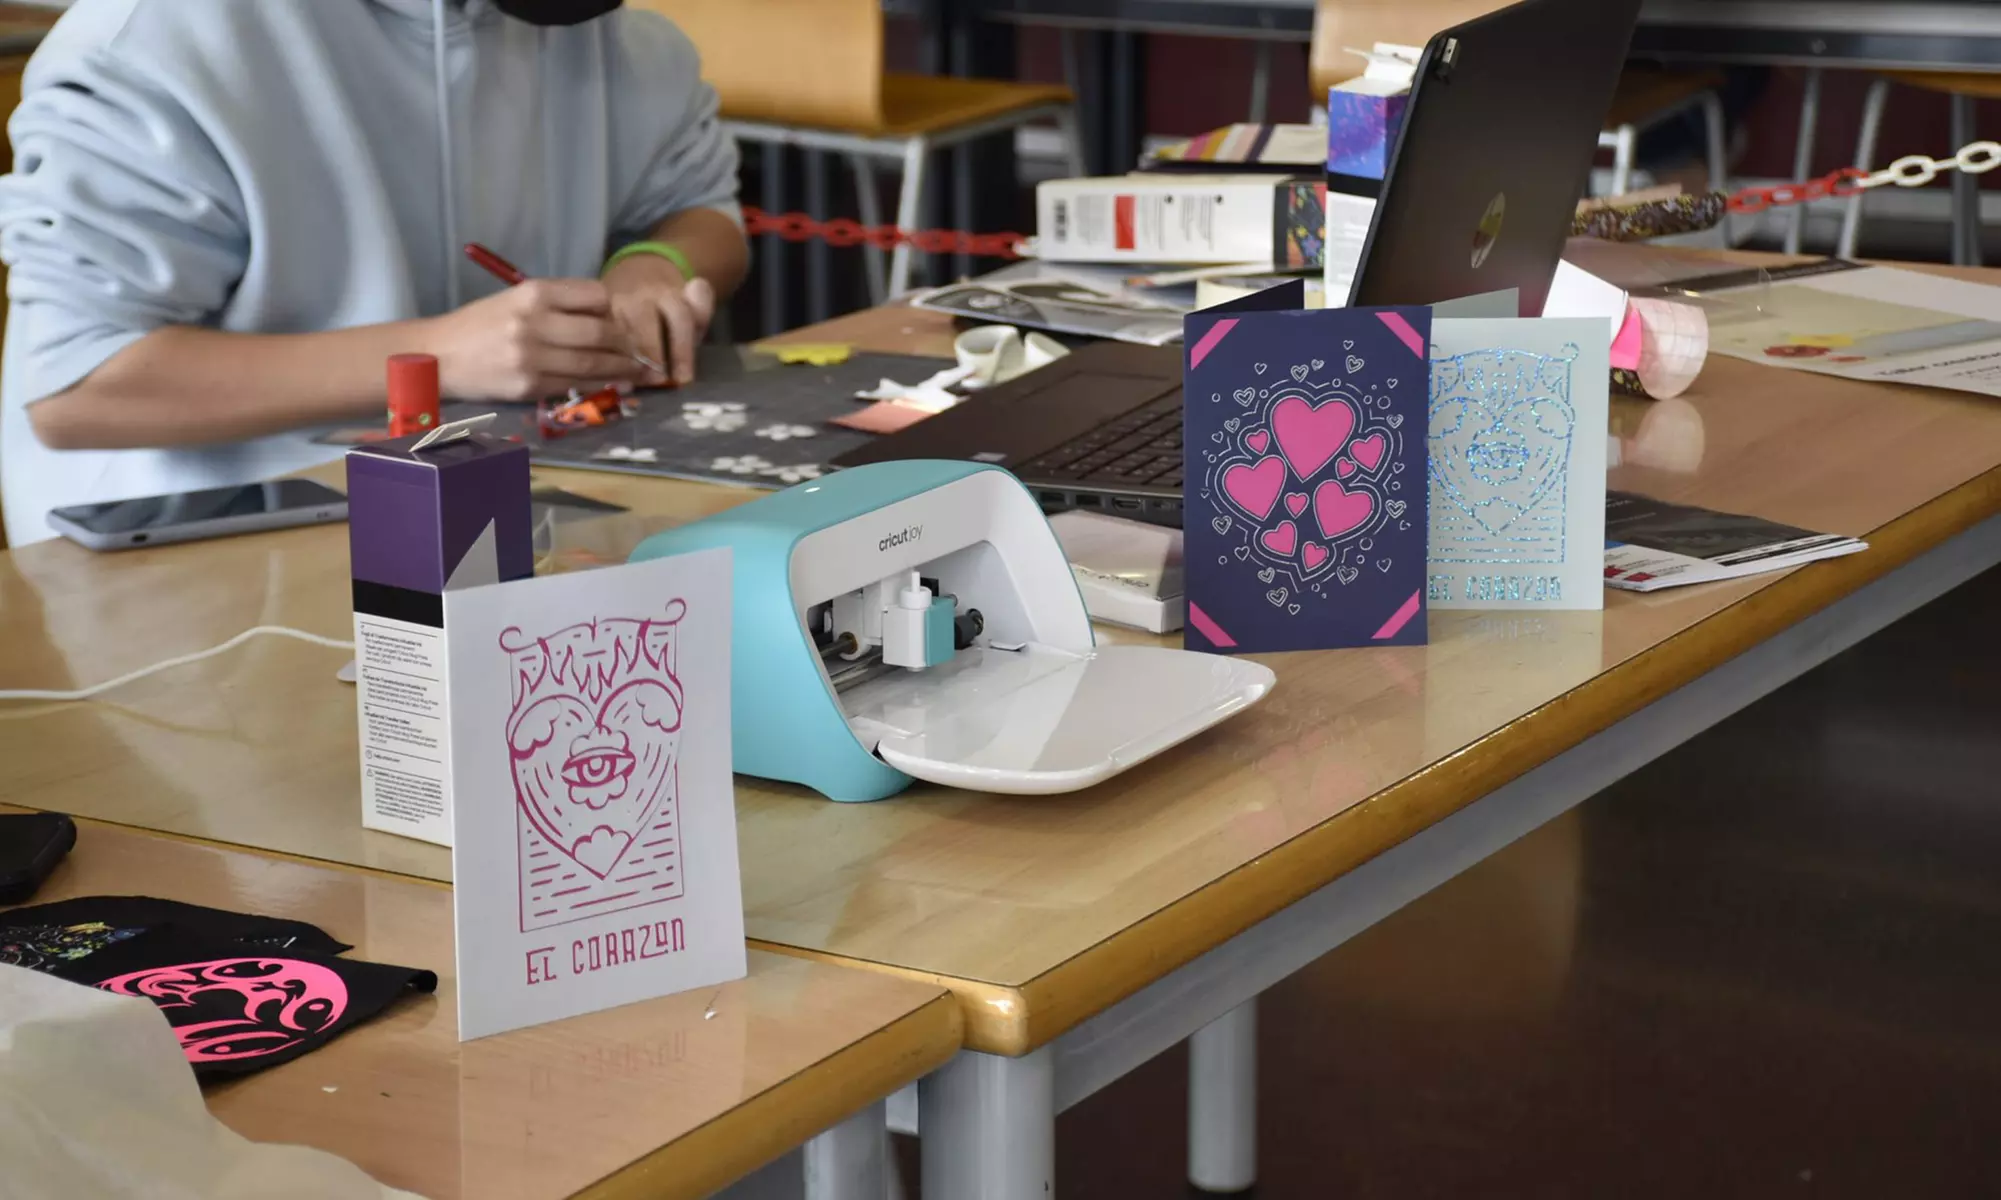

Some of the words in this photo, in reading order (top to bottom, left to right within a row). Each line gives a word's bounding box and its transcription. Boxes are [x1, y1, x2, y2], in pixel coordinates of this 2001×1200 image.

[879, 528, 908, 551] cricut
[908, 525, 923, 542] joy
[1429, 575, 1454, 600] EL
[1465, 575, 1562, 600] CORAZON
[526, 946, 557, 985] EL
[572, 917, 686, 975] CORAZON
